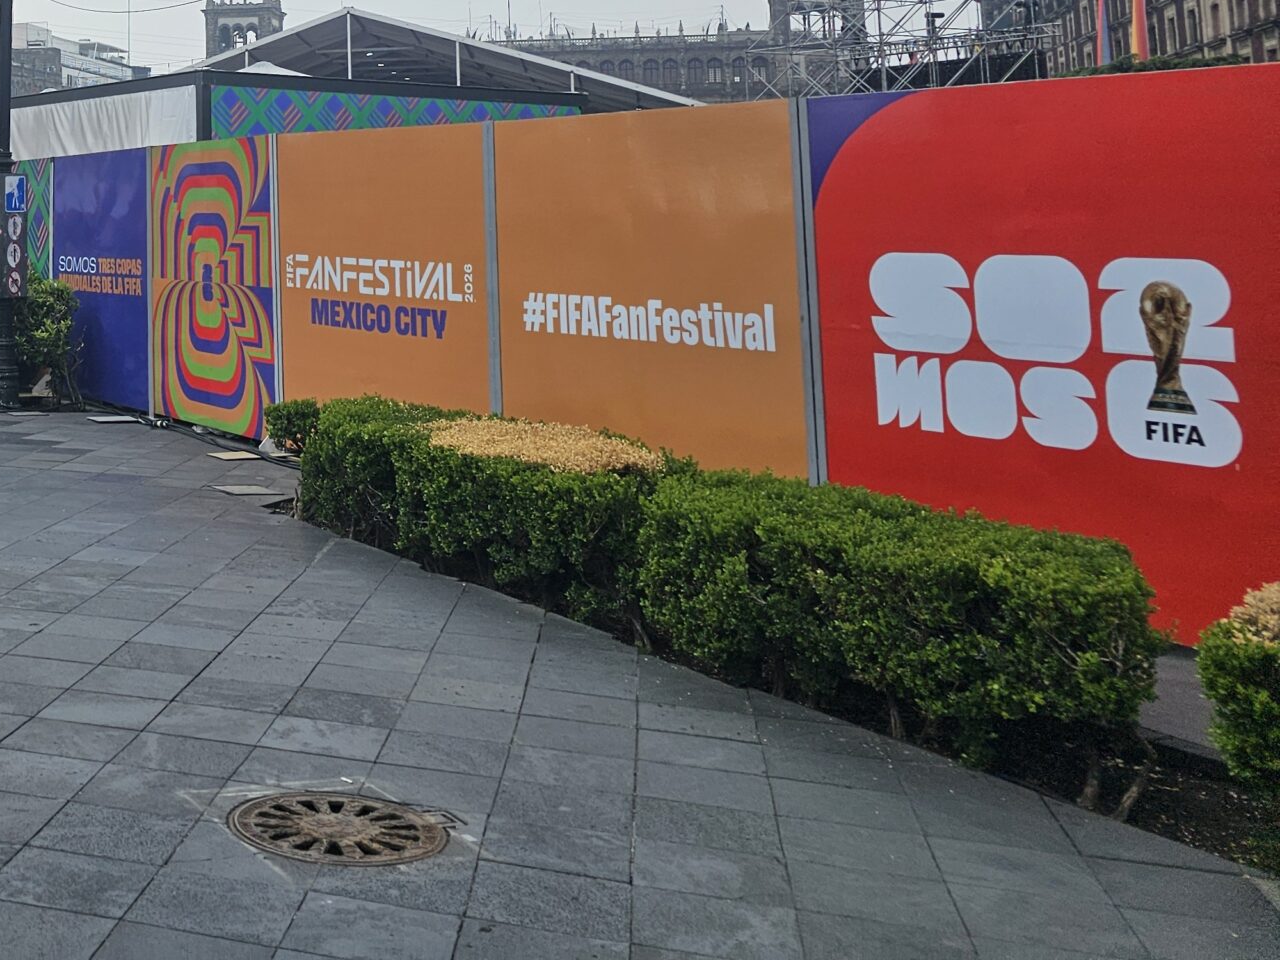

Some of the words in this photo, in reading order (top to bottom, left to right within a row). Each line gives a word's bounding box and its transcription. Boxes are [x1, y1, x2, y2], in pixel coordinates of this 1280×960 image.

[58, 256, 97, 274] SOMOS
[98, 258, 115, 274] TRES
[116, 258, 142, 276] COPAS
[285, 253, 294, 289] FIFA
[463, 263, 474, 303] 2026
[101, 276, 113, 294] DE
[113, 276, 124, 295] LA
[125, 277, 142, 297] FIFA
[310, 297, 391, 334] MEXICO
[395, 305, 448, 340] CITY
[522, 291, 776, 353] #FIFAFanFestival
[1144, 420, 1206, 447] FIFA
